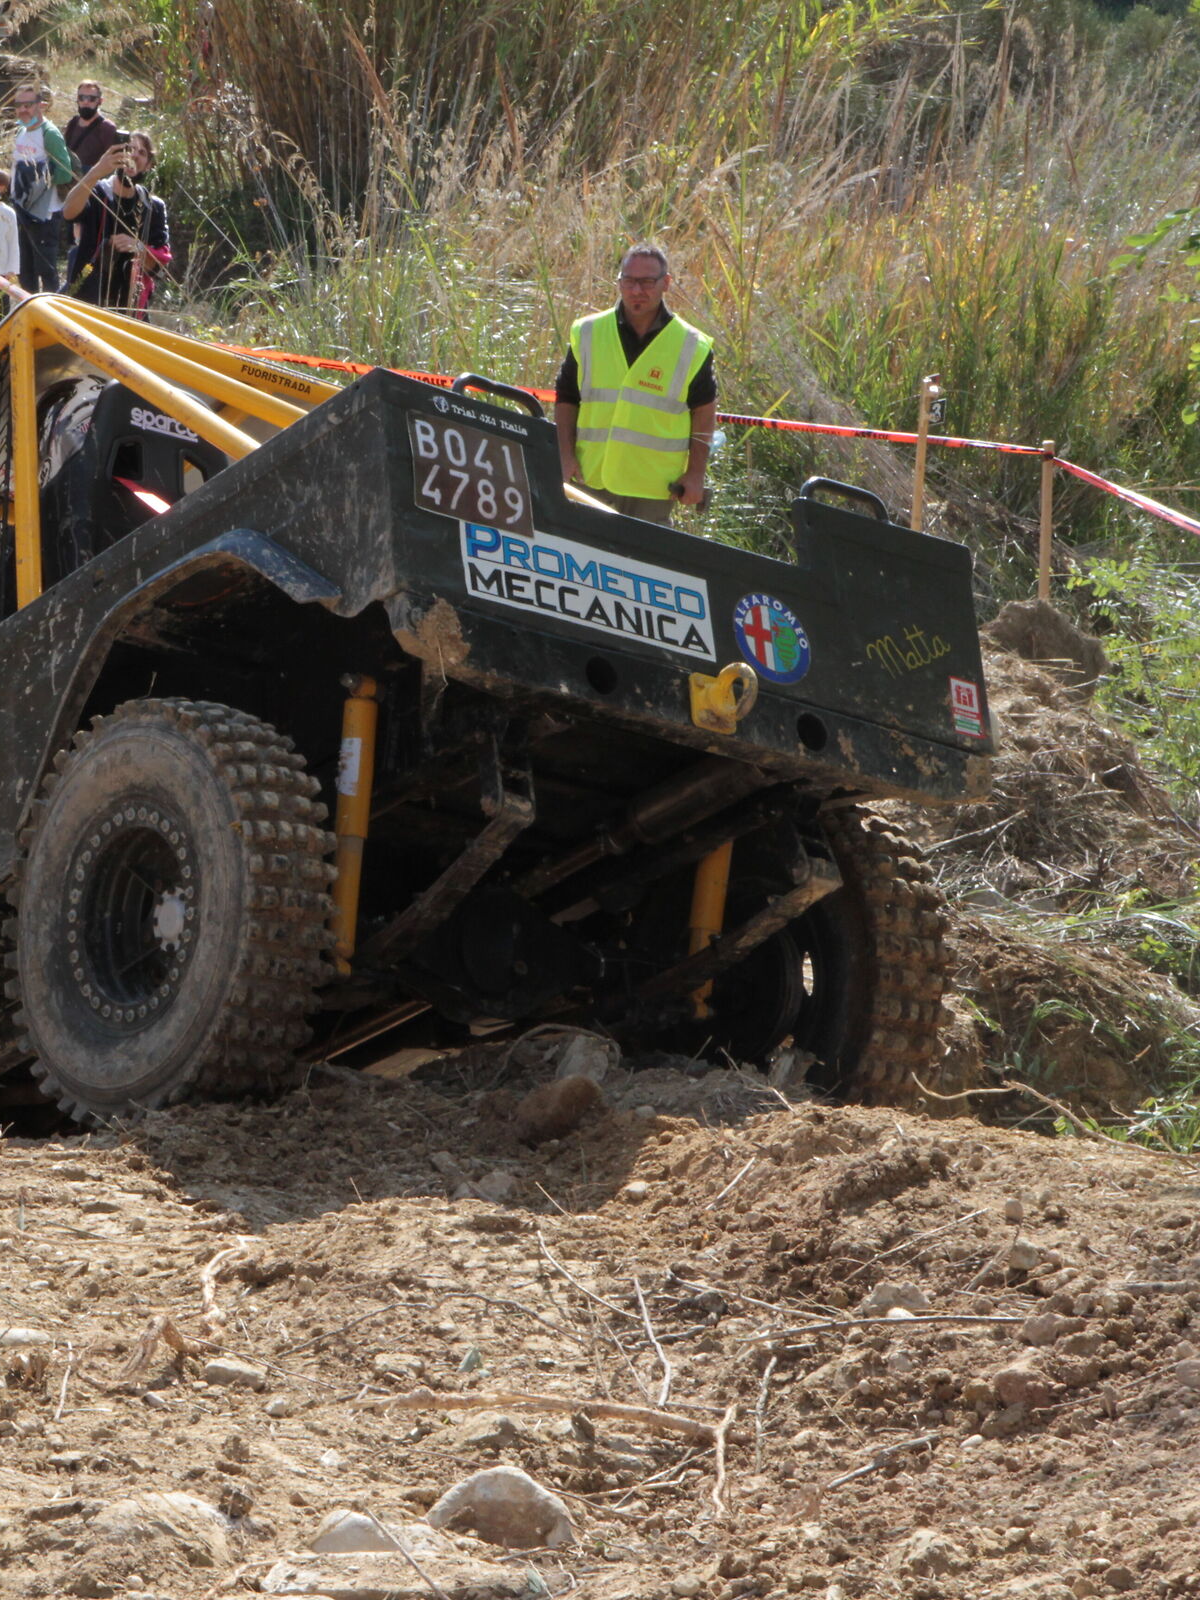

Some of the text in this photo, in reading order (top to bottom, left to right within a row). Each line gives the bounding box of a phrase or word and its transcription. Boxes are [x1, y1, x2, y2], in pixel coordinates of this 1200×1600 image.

[240, 364, 311, 395] FUORISTRADA
[451, 404, 477, 419] Trial
[499, 420, 528, 437] Italia
[930, 402, 942, 423] 3
[421, 464, 524, 524] 4789
[465, 522, 706, 620] PROMETEO
[467, 562, 711, 655] MECCANICA
[866, 624, 951, 679] Matta
